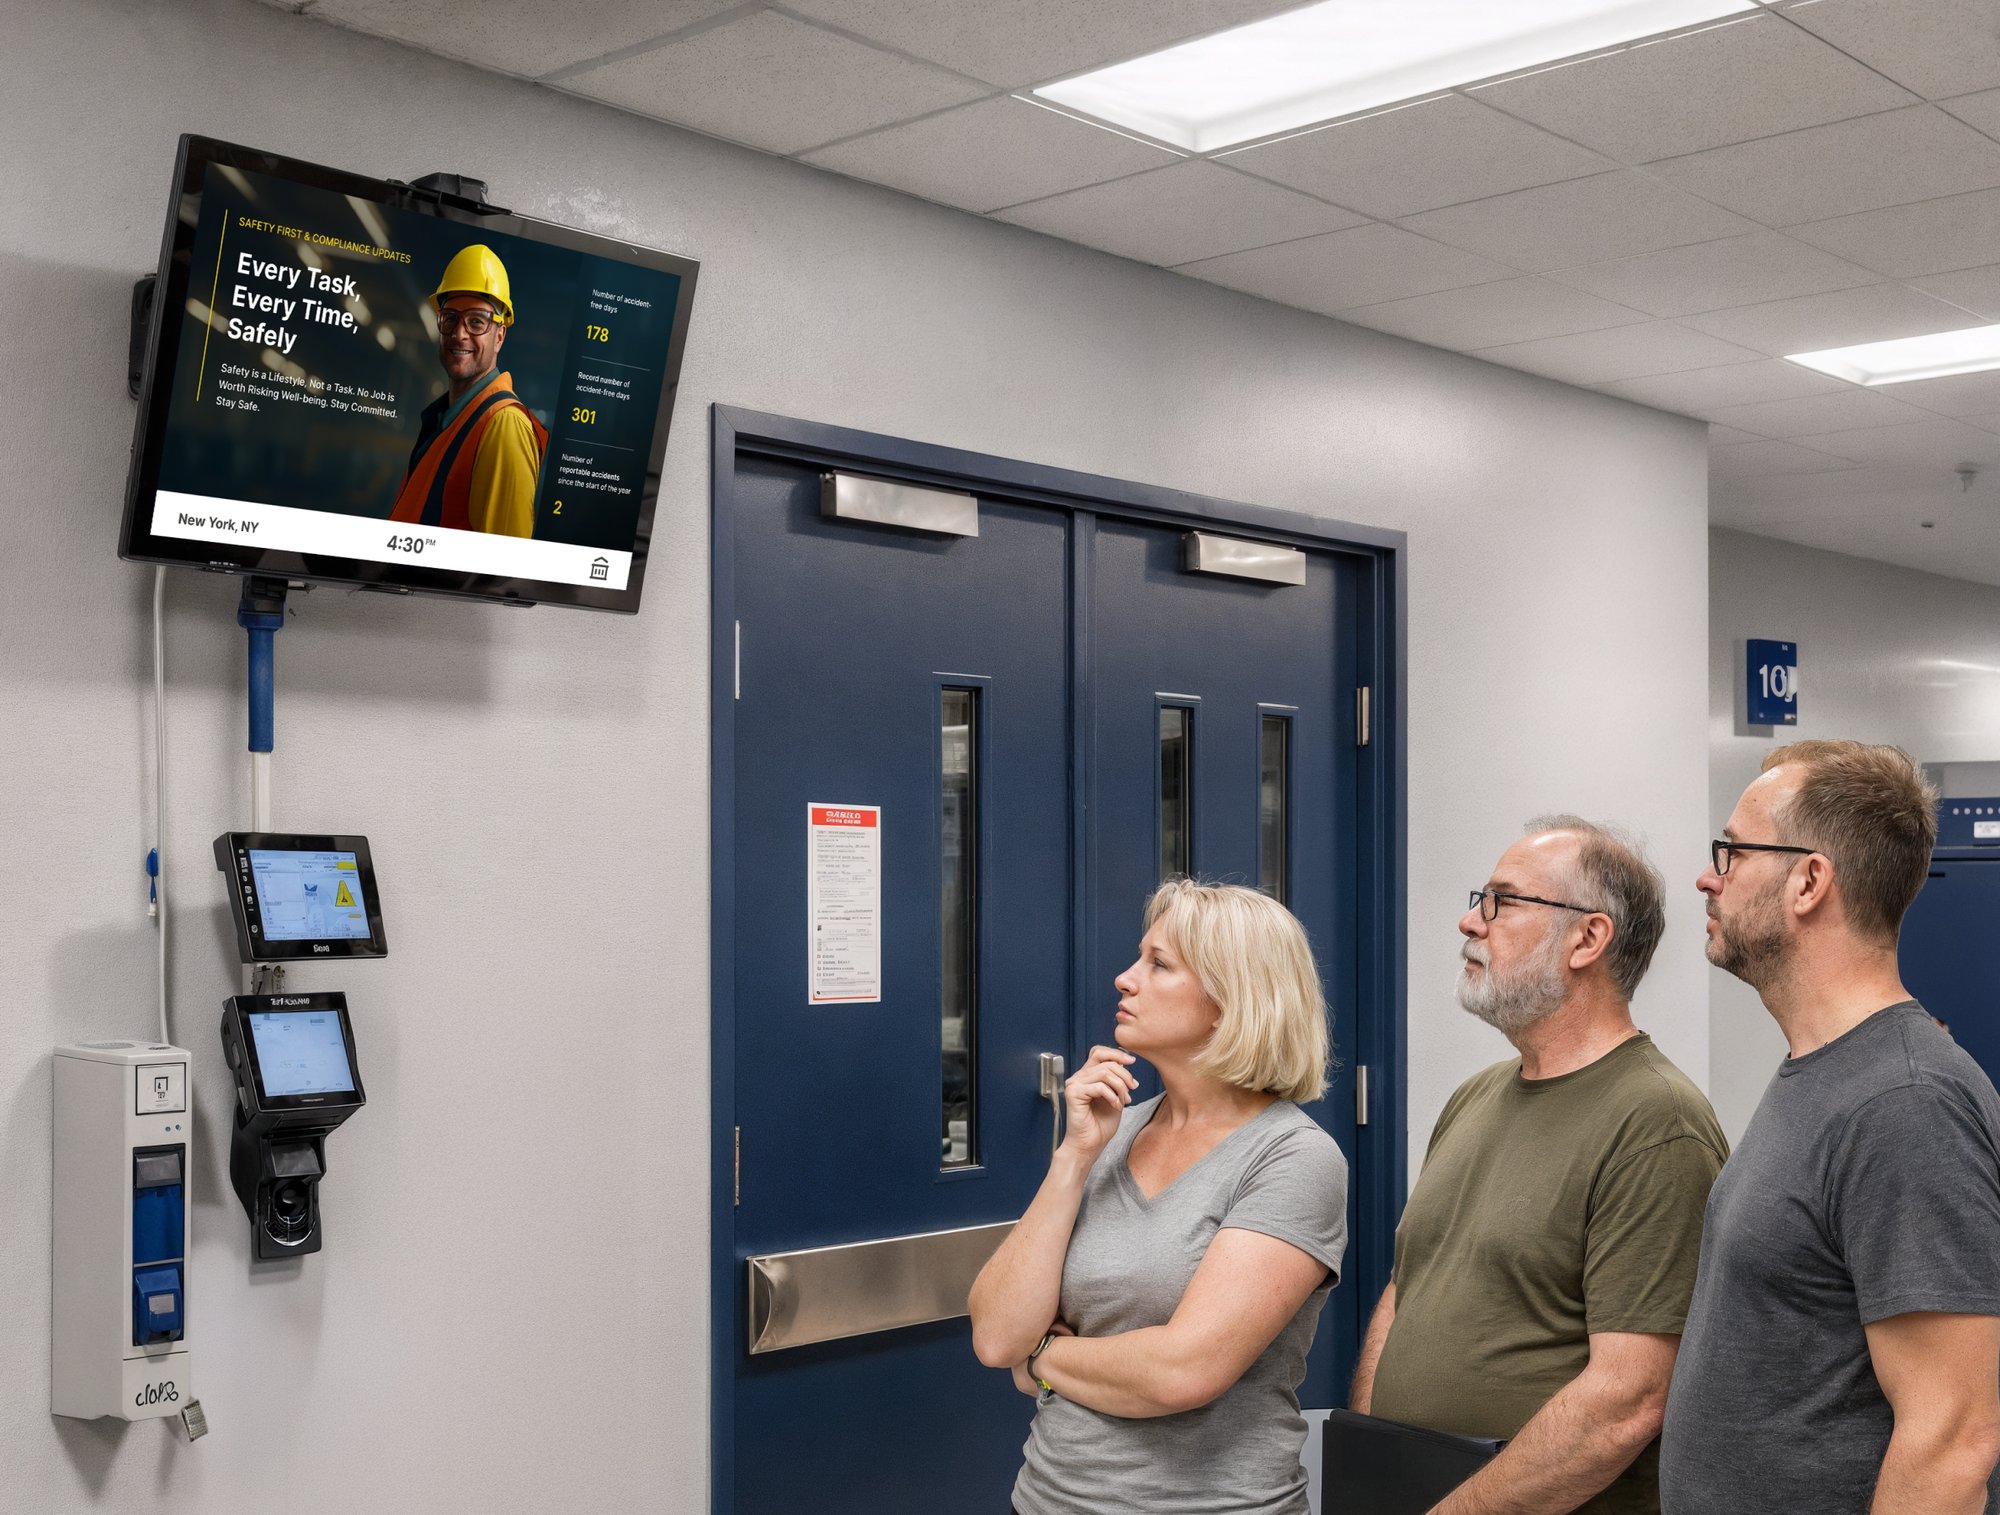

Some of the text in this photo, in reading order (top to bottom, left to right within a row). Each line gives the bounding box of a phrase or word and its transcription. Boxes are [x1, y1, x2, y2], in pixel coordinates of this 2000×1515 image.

[239, 216, 412, 264] SAFETY FIRST & COMPLIANCE UPDATES
[237, 251, 361, 302] Every Task,
[590, 301, 618, 314] free days
[591, 289, 652, 309] Number of accident-
[232, 284, 359, 334] Every Time,
[227, 317, 297, 354] Safely
[586, 324, 609, 342] 178
[220, 363, 395, 402] Safety is a Lifestyle, Not a Task. No Job is
[577, 371, 600, 382] Record
[600, 377, 623, 387] number
[218, 379, 398, 419] Worth Risking Well-being. Stay Committed.
[575, 384, 630, 401] accident-free days
[215, 396, 260, 412] Stay Safe.
[571, 407, 597, 425] 301
[561, 453, 594, 465] Number of
[559, 465, 620, 481] reportable accidents
[557, 477, 631, 495] since the start of the year
[552, 500, 563, 515] 2
[178, 512, 260, 534] New York, NY
[386, 534, 436, 554] 4:30 PM
